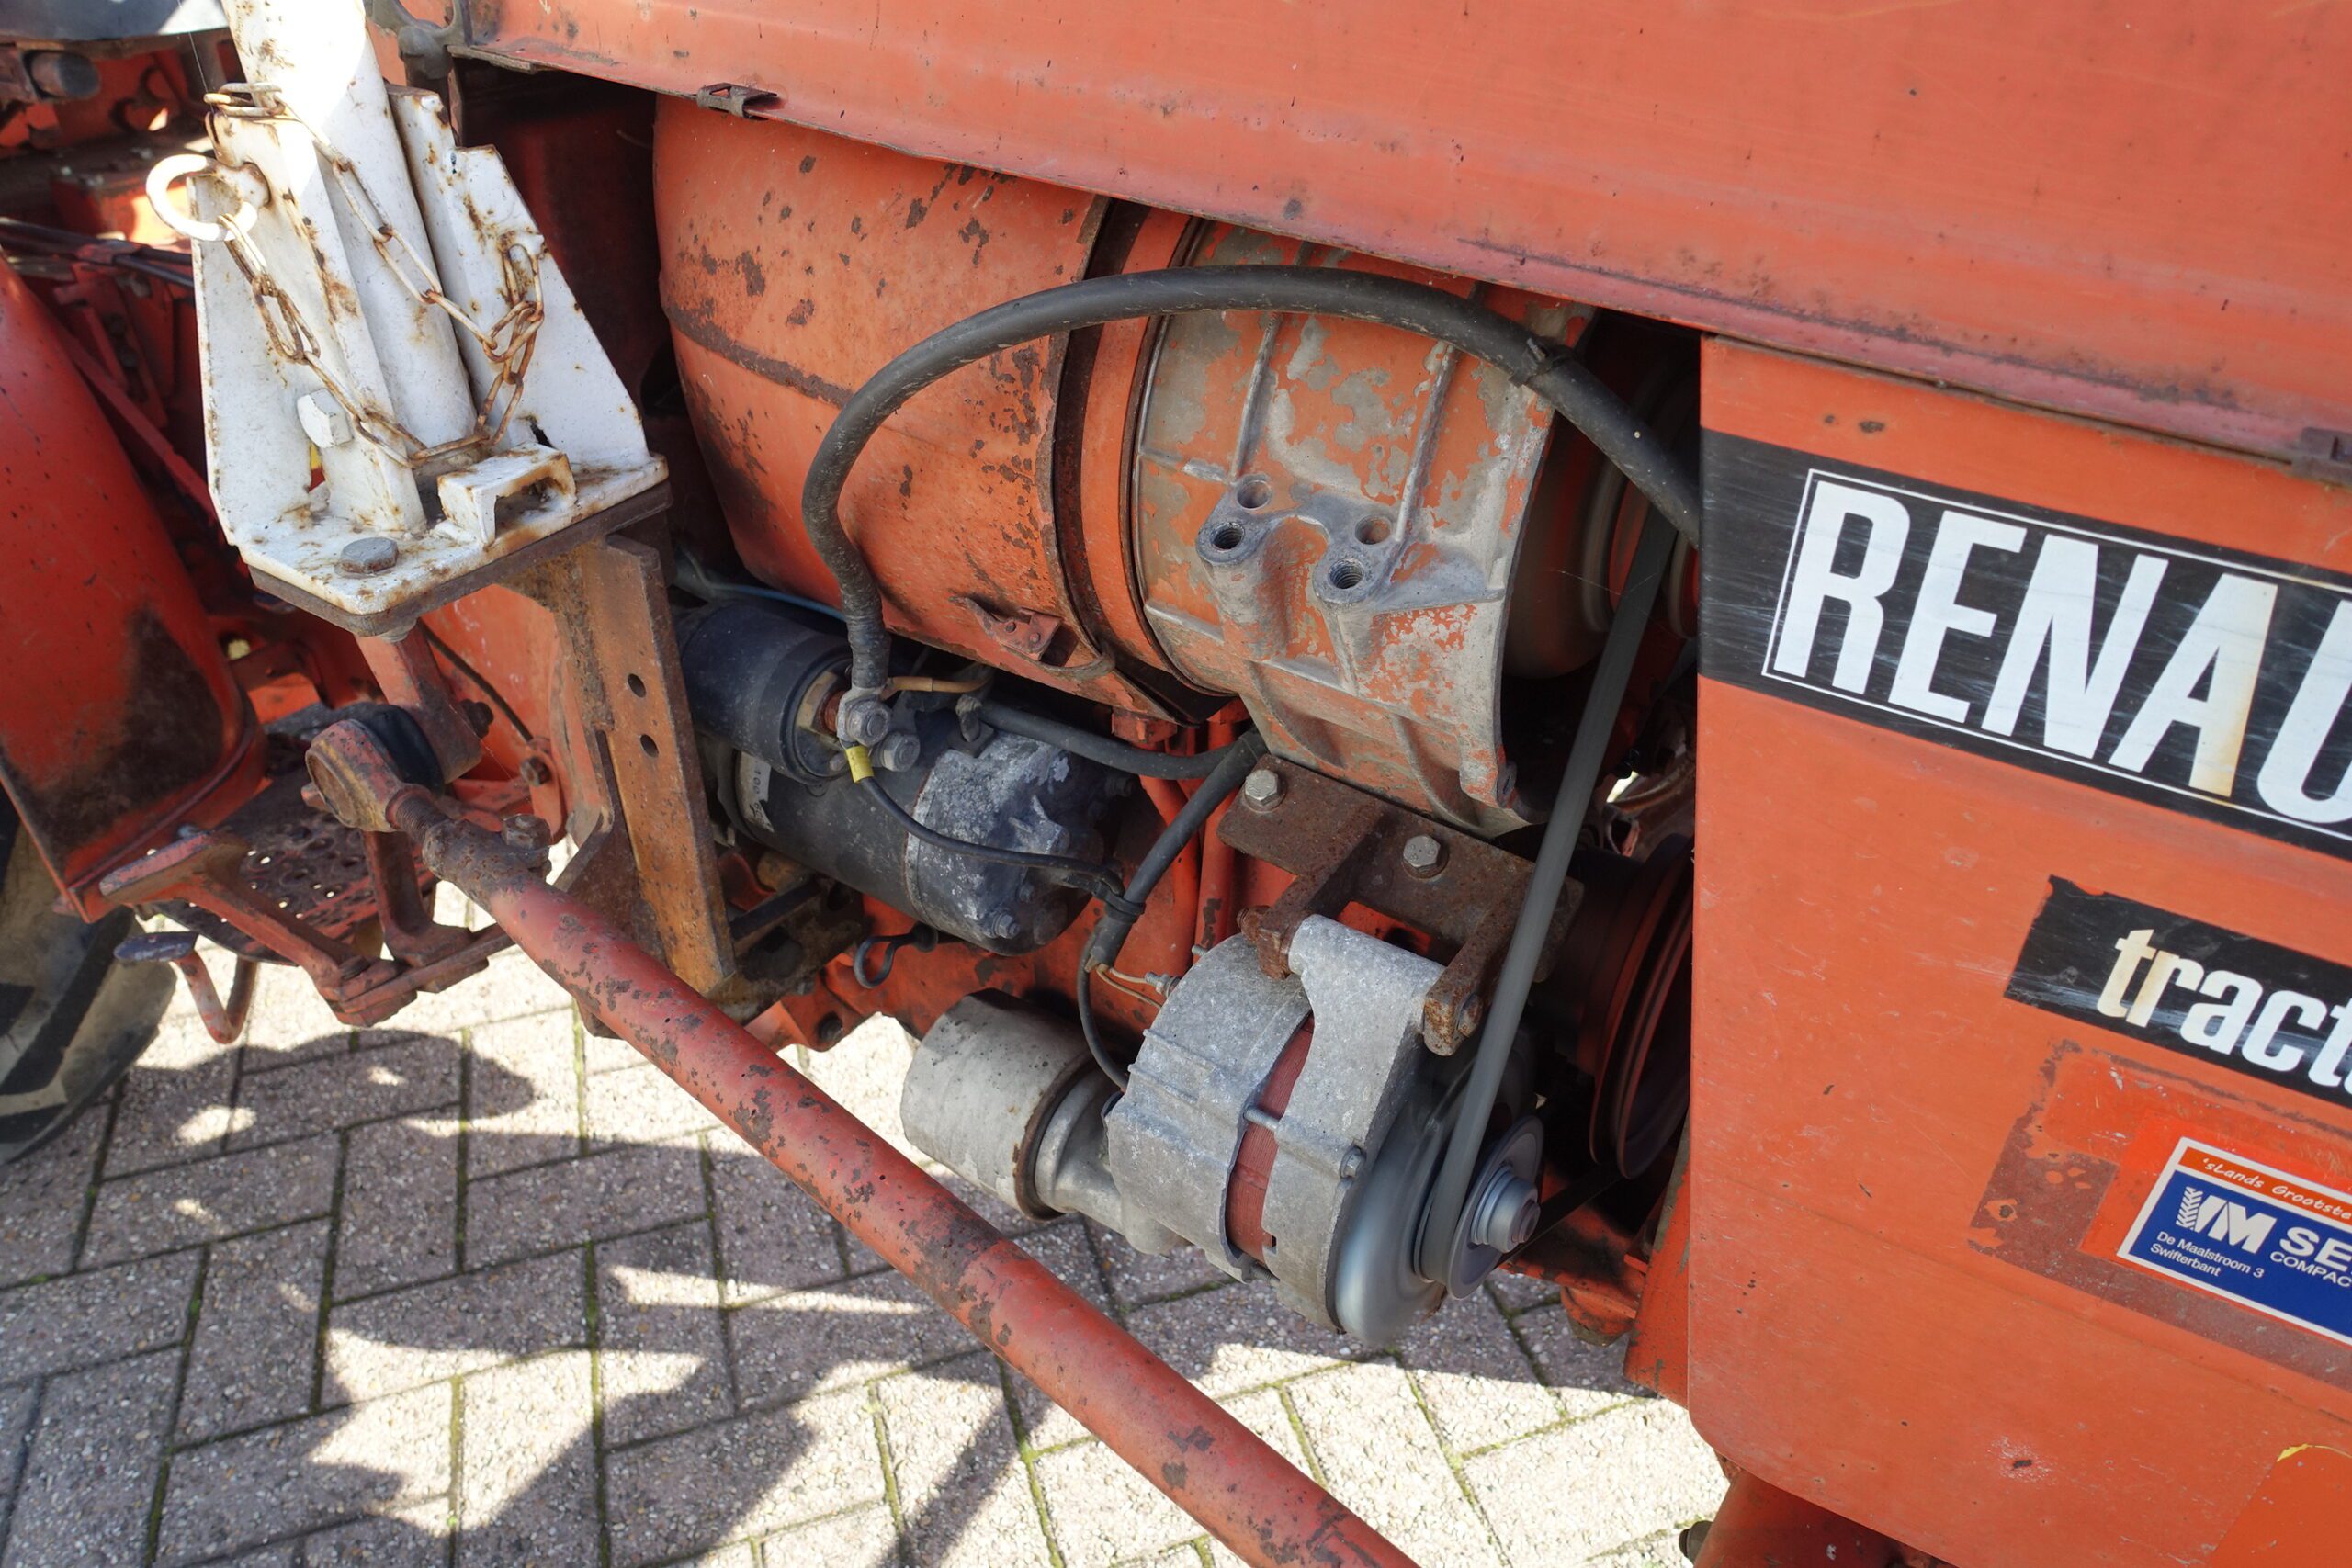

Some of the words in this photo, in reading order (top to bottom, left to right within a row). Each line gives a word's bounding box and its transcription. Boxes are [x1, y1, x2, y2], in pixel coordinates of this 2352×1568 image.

[1773, 480, 2352, 823] RENAU
[2097, 929, 2352, 1094] tract
[2272, 1185, 2352, 1219] Grootste
[2150, 1243, 2222, 1277] Swifterbant
[2157, 1231, 2176, 1245] De
[2177, 1239, 2251, 1274] Maalstroom
[2253, 1268, 2265, 1279] 3
[2270, 1251, 2352, 1287] COMPAC
[2279, 1227, 2352, 1273] SE
